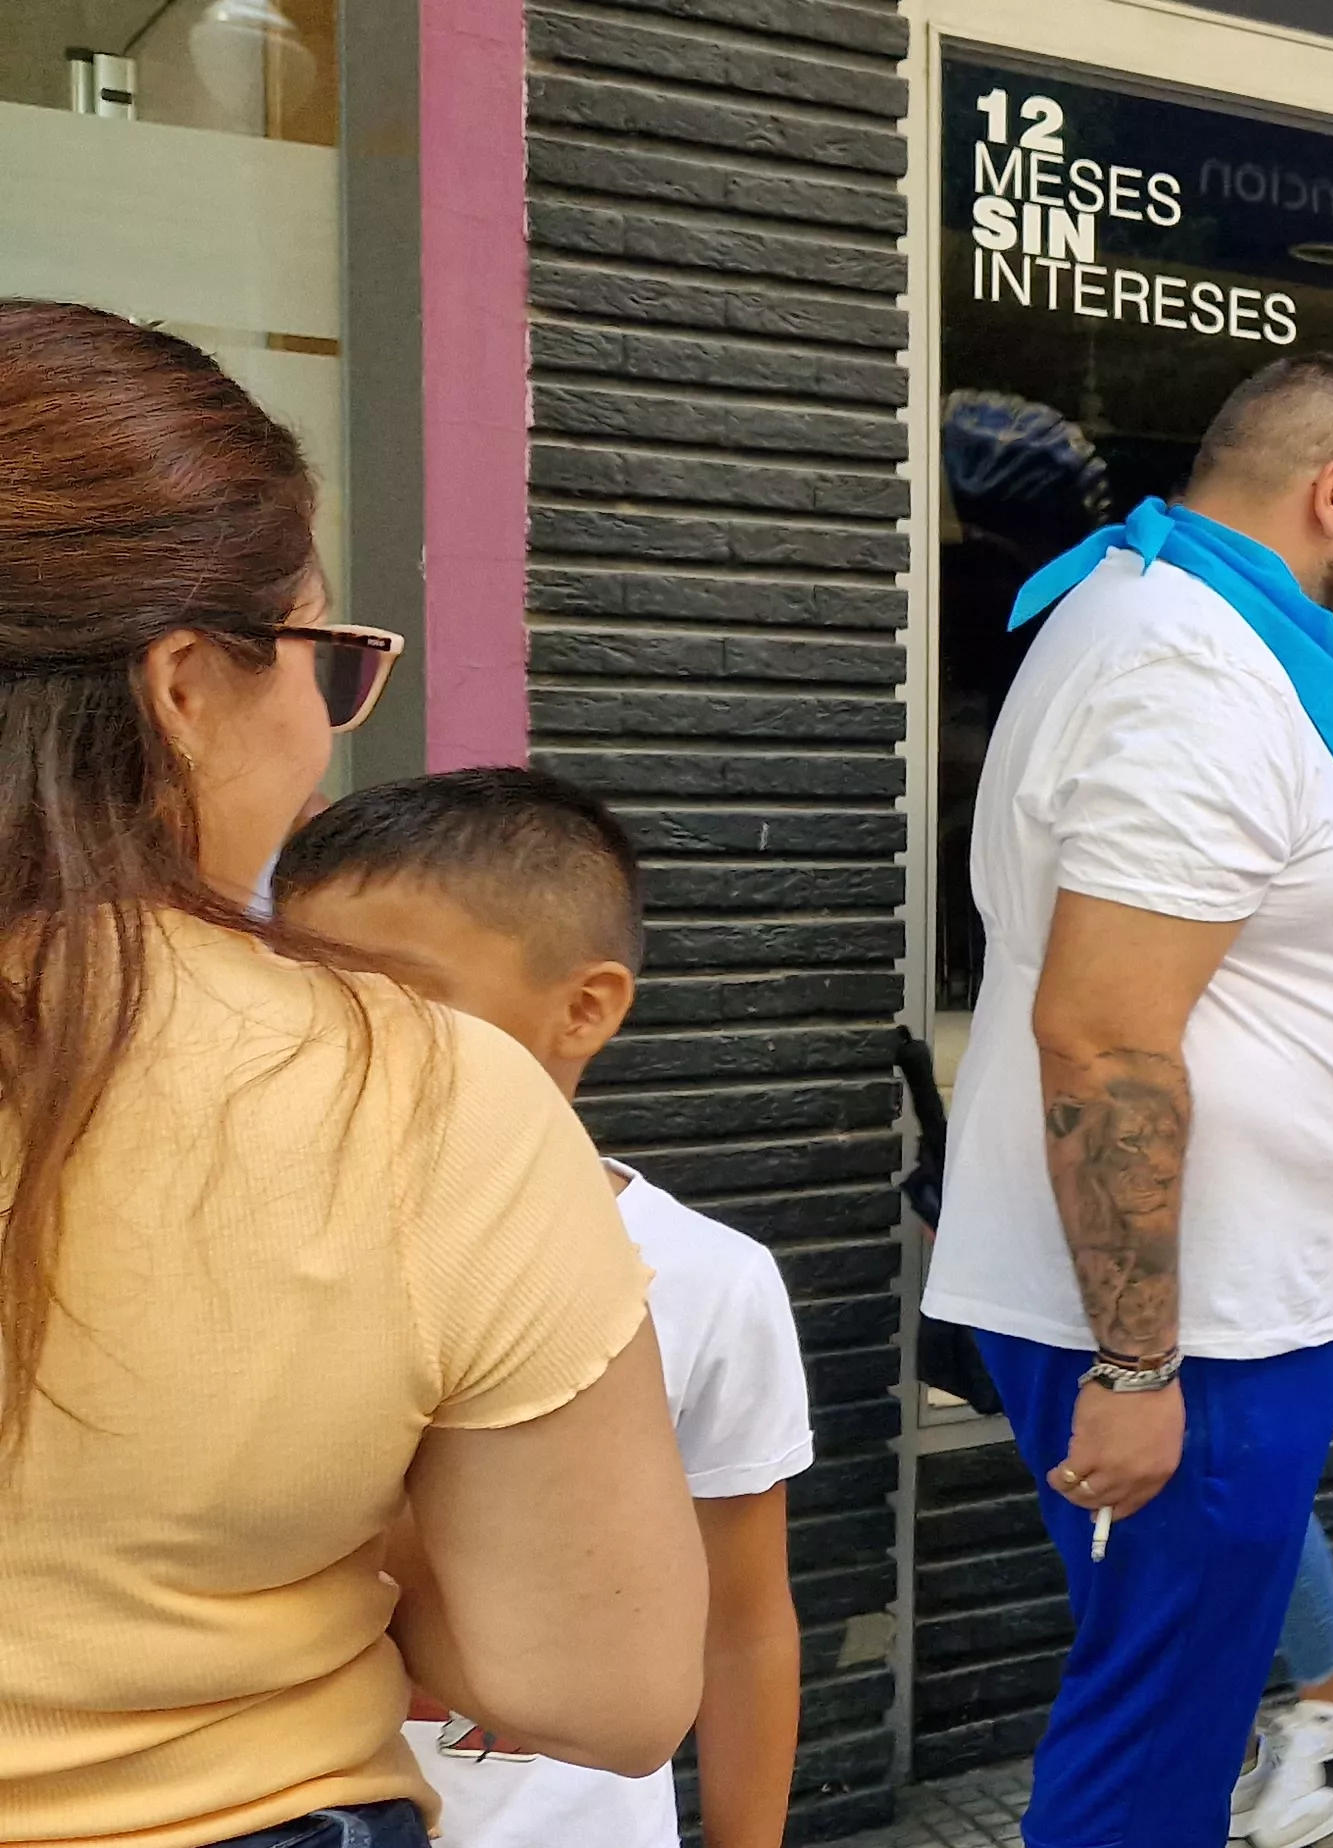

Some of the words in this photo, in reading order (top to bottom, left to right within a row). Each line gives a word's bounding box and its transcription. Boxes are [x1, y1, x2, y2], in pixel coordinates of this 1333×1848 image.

[976, 87, 1064, 154] 12
[973, 140, 1182, 227] MESES
[971, 194, 1096, 264] SIN
[973, 247, 1297, 345] INTERESES
